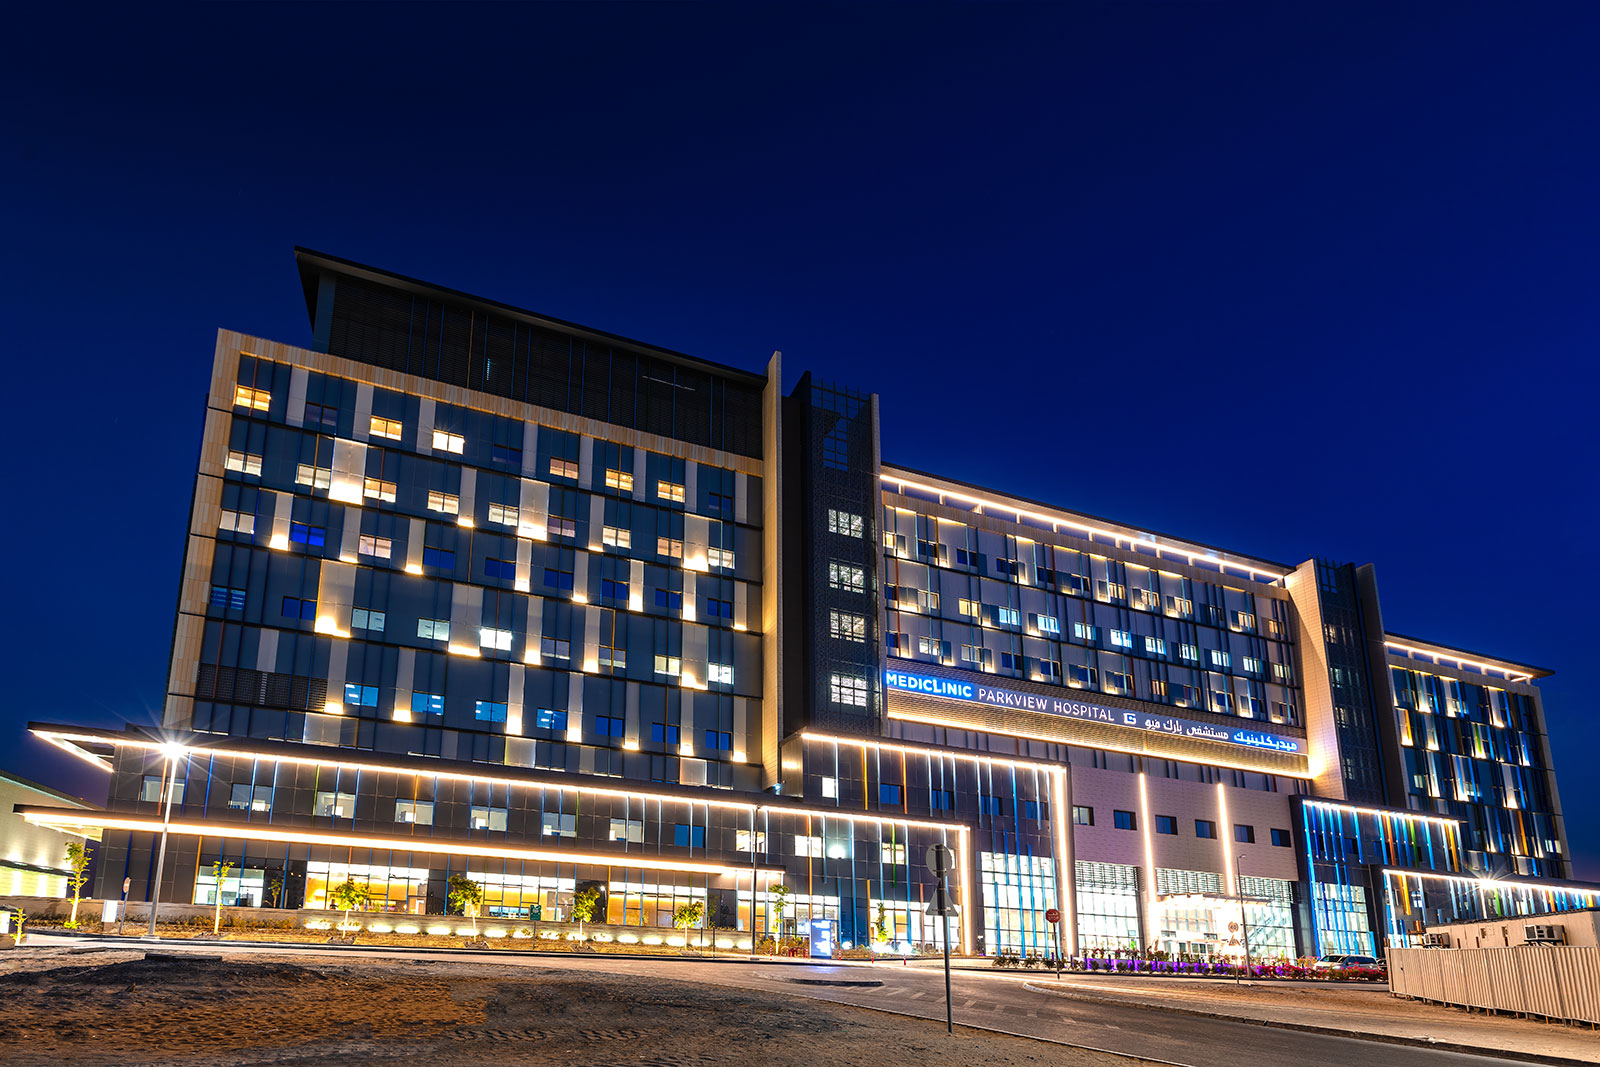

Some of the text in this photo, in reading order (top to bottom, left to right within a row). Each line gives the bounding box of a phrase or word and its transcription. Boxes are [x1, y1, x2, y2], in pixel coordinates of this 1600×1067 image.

[886, 672, 1115, 721] MEDICLINIC PARKVIEW HOSPITAL
[1163, 719, 1182, 736] بارك
[1186, 726, 1229, 740] مستشفى
[1234, 732, 1298, 750] ميديكلينيك
